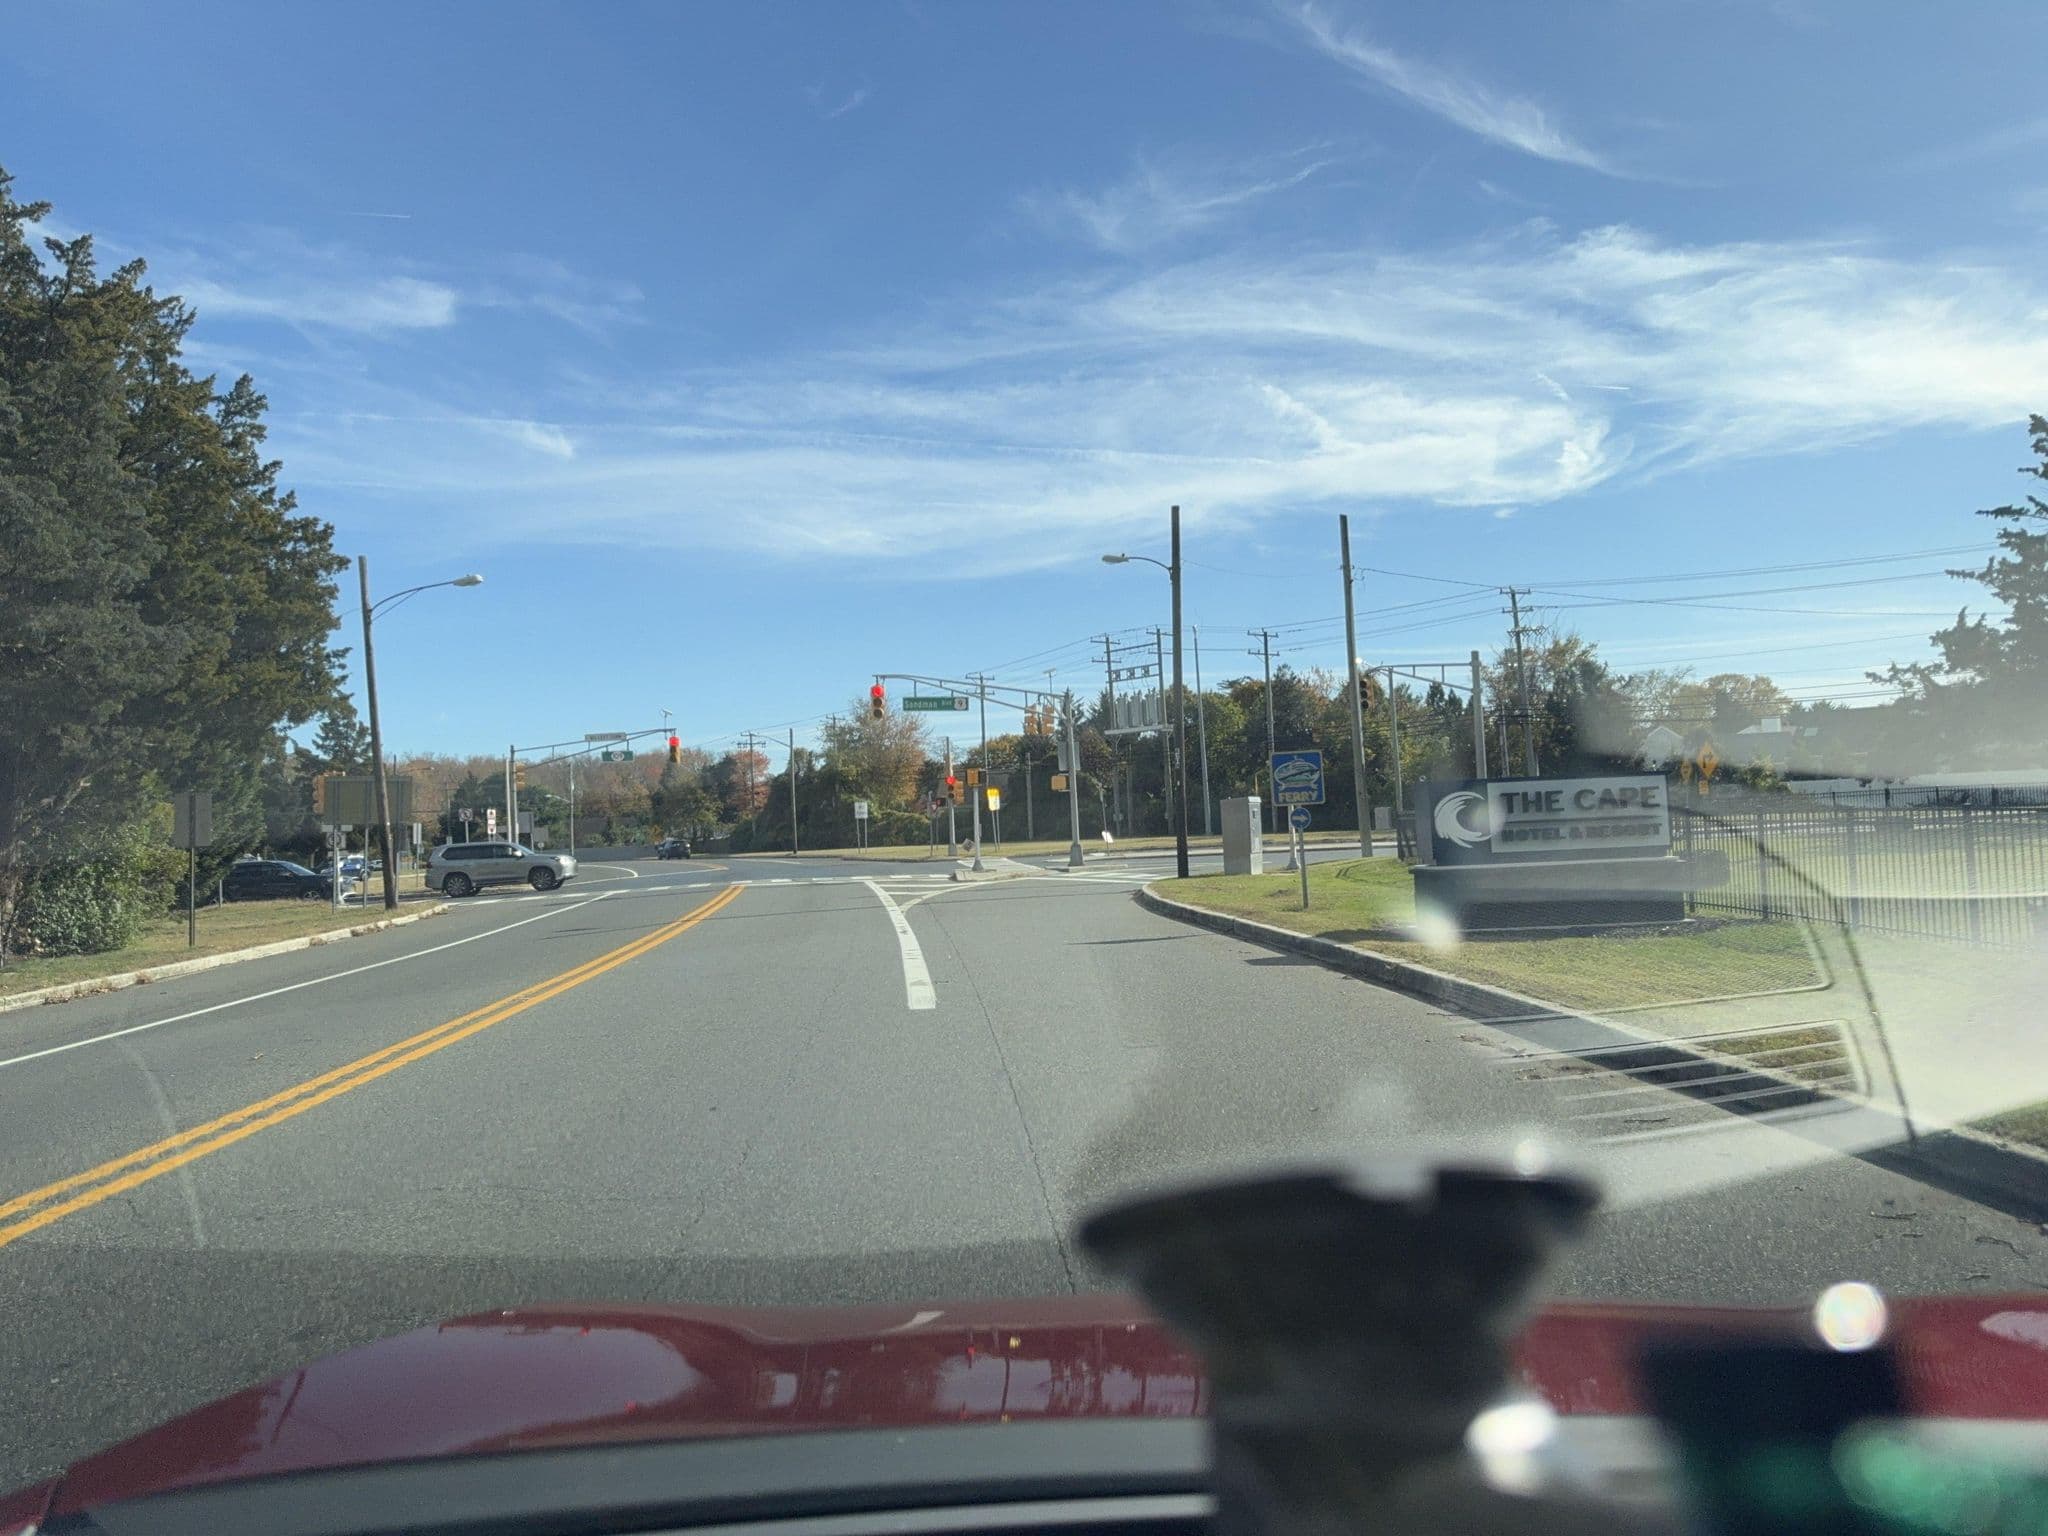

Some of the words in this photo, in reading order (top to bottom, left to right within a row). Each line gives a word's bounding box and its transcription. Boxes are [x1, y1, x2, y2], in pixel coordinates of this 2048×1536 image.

[1279, 791, 1318, 803] FERRY
[1500, 789, 1564, 814] THE
[1574, 785, 1661, 812] CAPE
